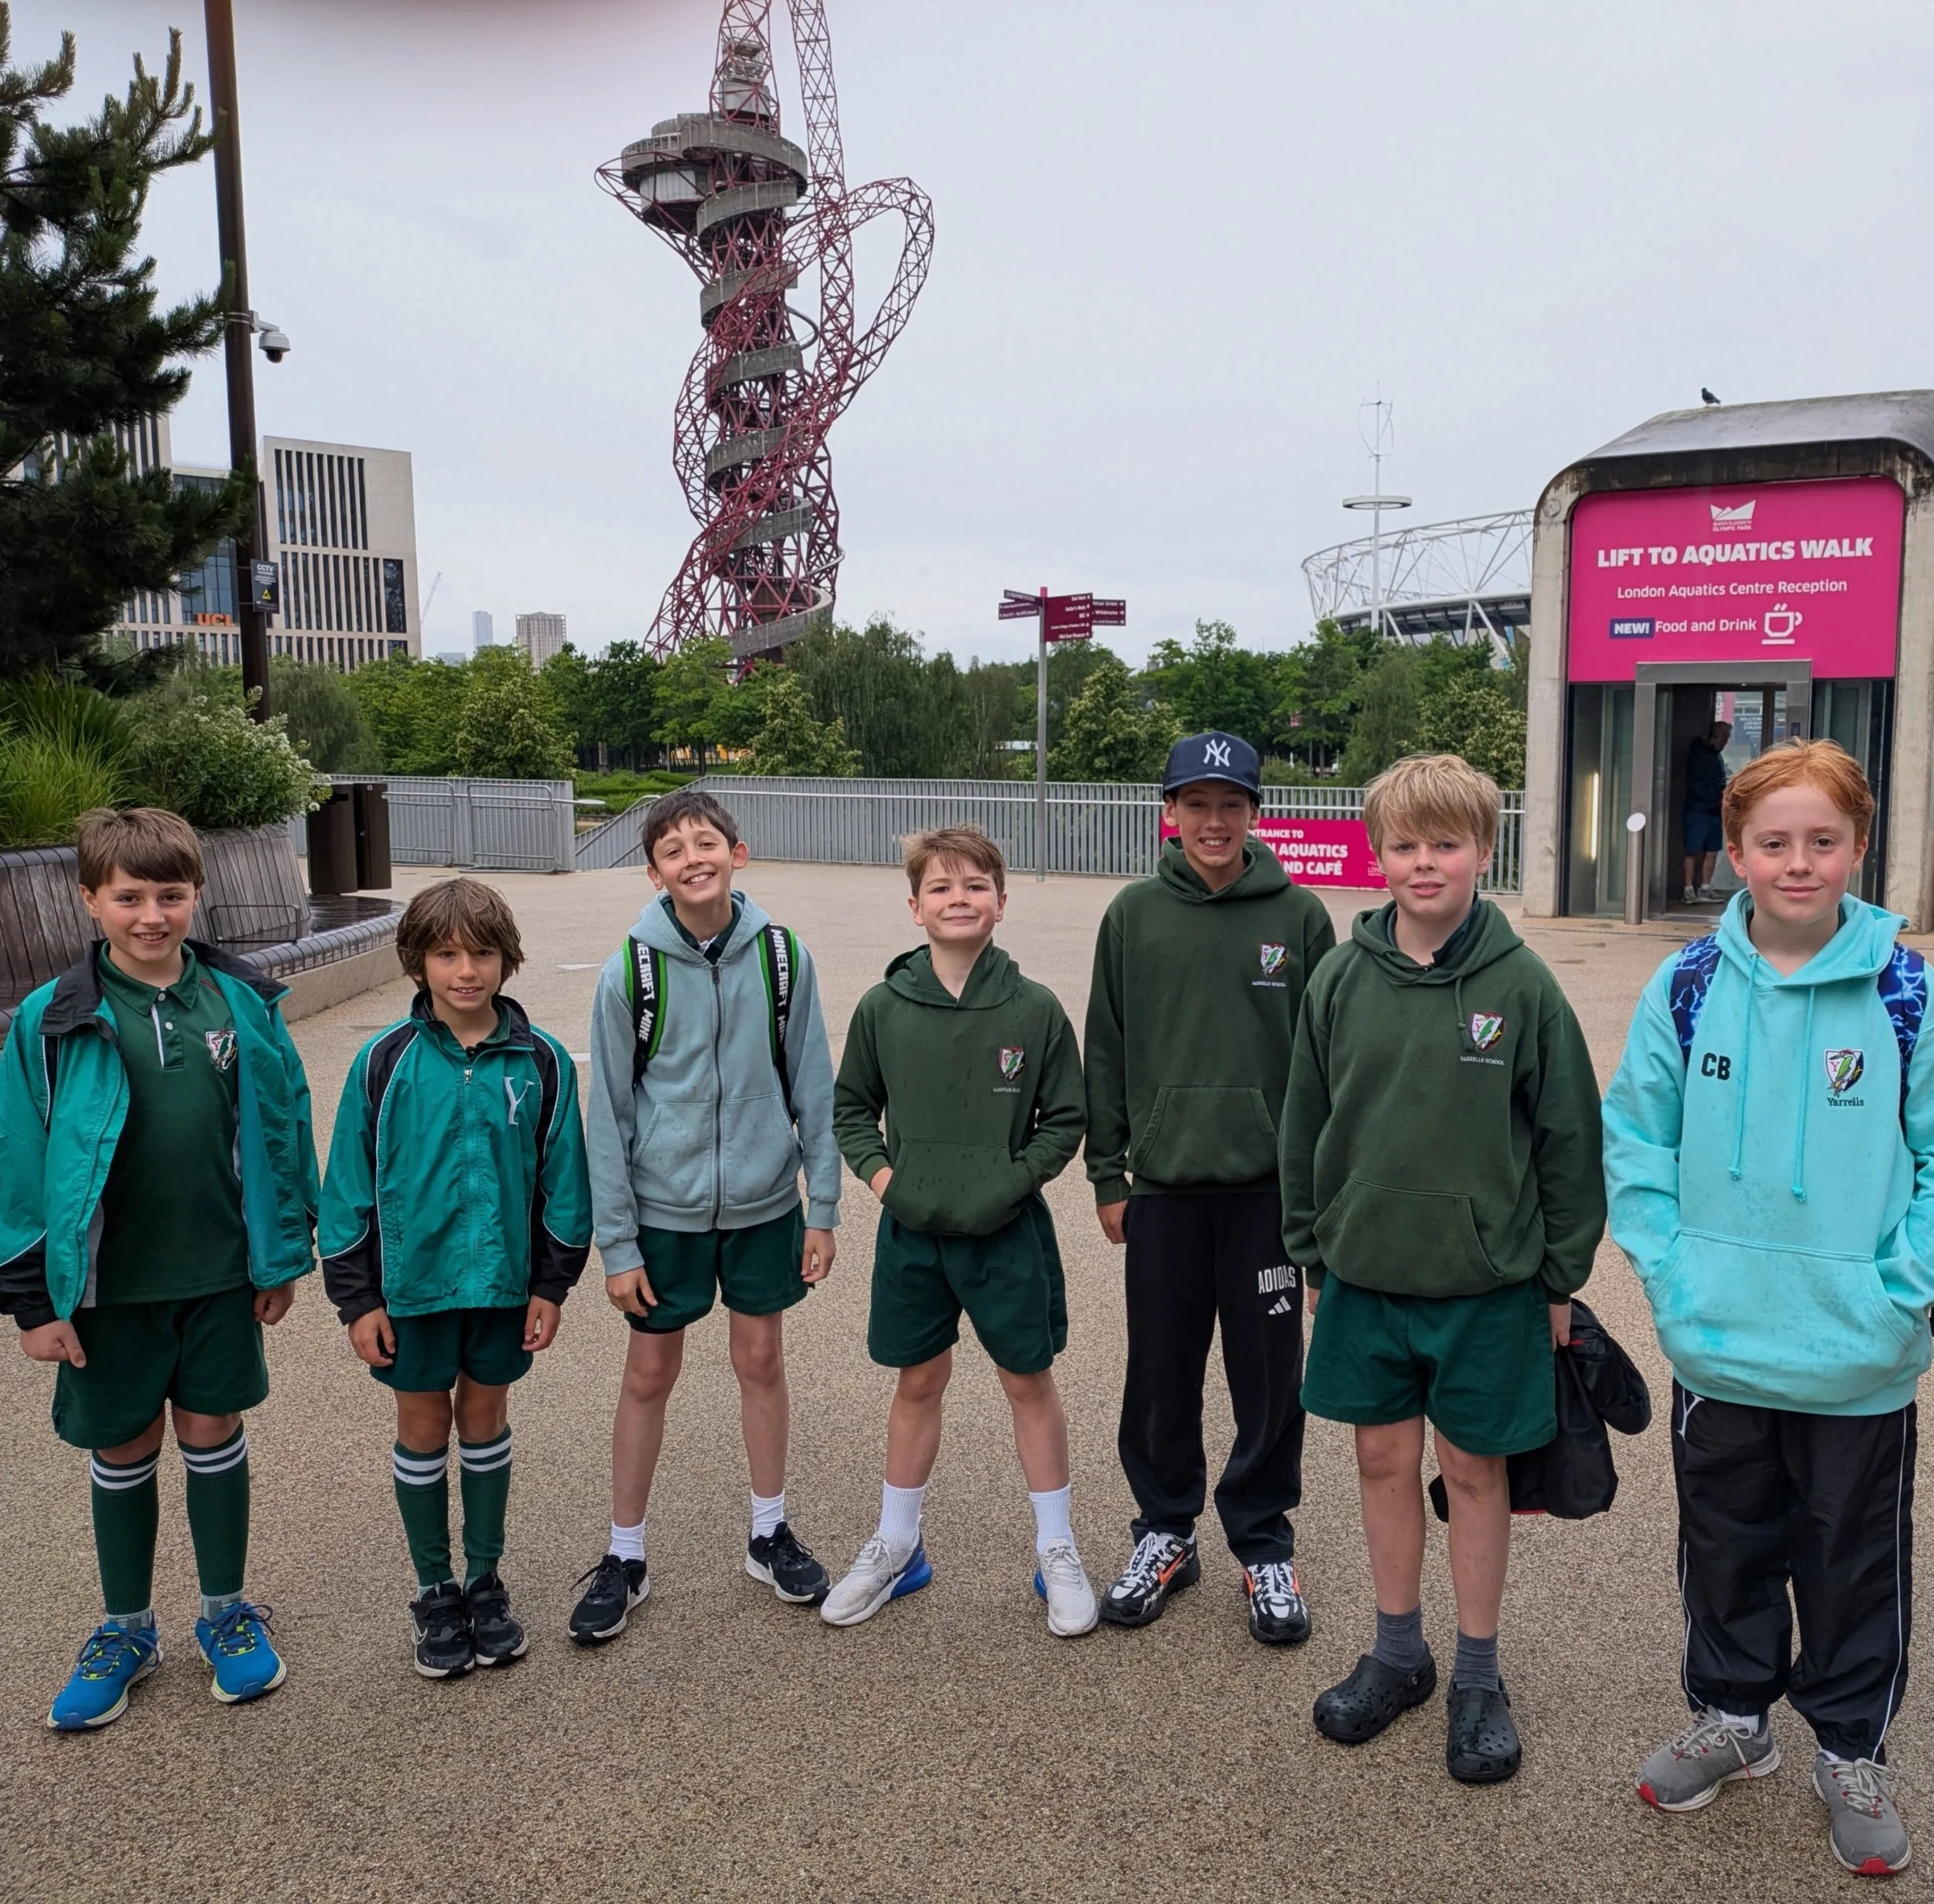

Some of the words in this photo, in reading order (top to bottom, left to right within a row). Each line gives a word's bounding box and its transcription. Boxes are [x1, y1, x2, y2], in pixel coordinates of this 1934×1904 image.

[1597, 547, 1644, 567] LIFT
[1648, 546, 1678, 566] TO
[1681, 541, 1796, 566] AQUATICS
[1800, 537, 1874, 559] WALK
[257, 563, 273, 572] CCTV
[1618, 585, 1665, 599] London
[1669, 583, 1726, 598] Aquatics
[1729, 582, 1774, 595] Centre
[1778, 579, 1847, 594] Reception
[197, 613, 235, 627] UCL
[1614, 622, 1650, 634] NEW!
[1656, 620, 1687, 633] Food
[1690, 620, 1715, 632] and
[1719, 618, 1757, 631] Drink
[1203, 738, 1232, 767] NY
[1247, 829, 1290, 838] NTRANCE
[1291, 829, 1304, 839] TO
[1278, 843, 1348, 858] AQUATICS
[1280, 860, 1304, 874] ND
[1306, 860, 1343, 876] CAFÉ
[637, 942, 655, 1001] ECRAFT
[770, 928, 789, 1007] MINECRAFT
[638, 1008, 654, 1043] MINE
[1700, 1052, 1731, 1081] CB
[1829, 1061, 1840, 1072] Y
[504, 1076, 535, 1125] Y
[1826, 1096, 1864, 1107] Yarrells
[1258, 1265, 1297, 1294] ADIDAS
